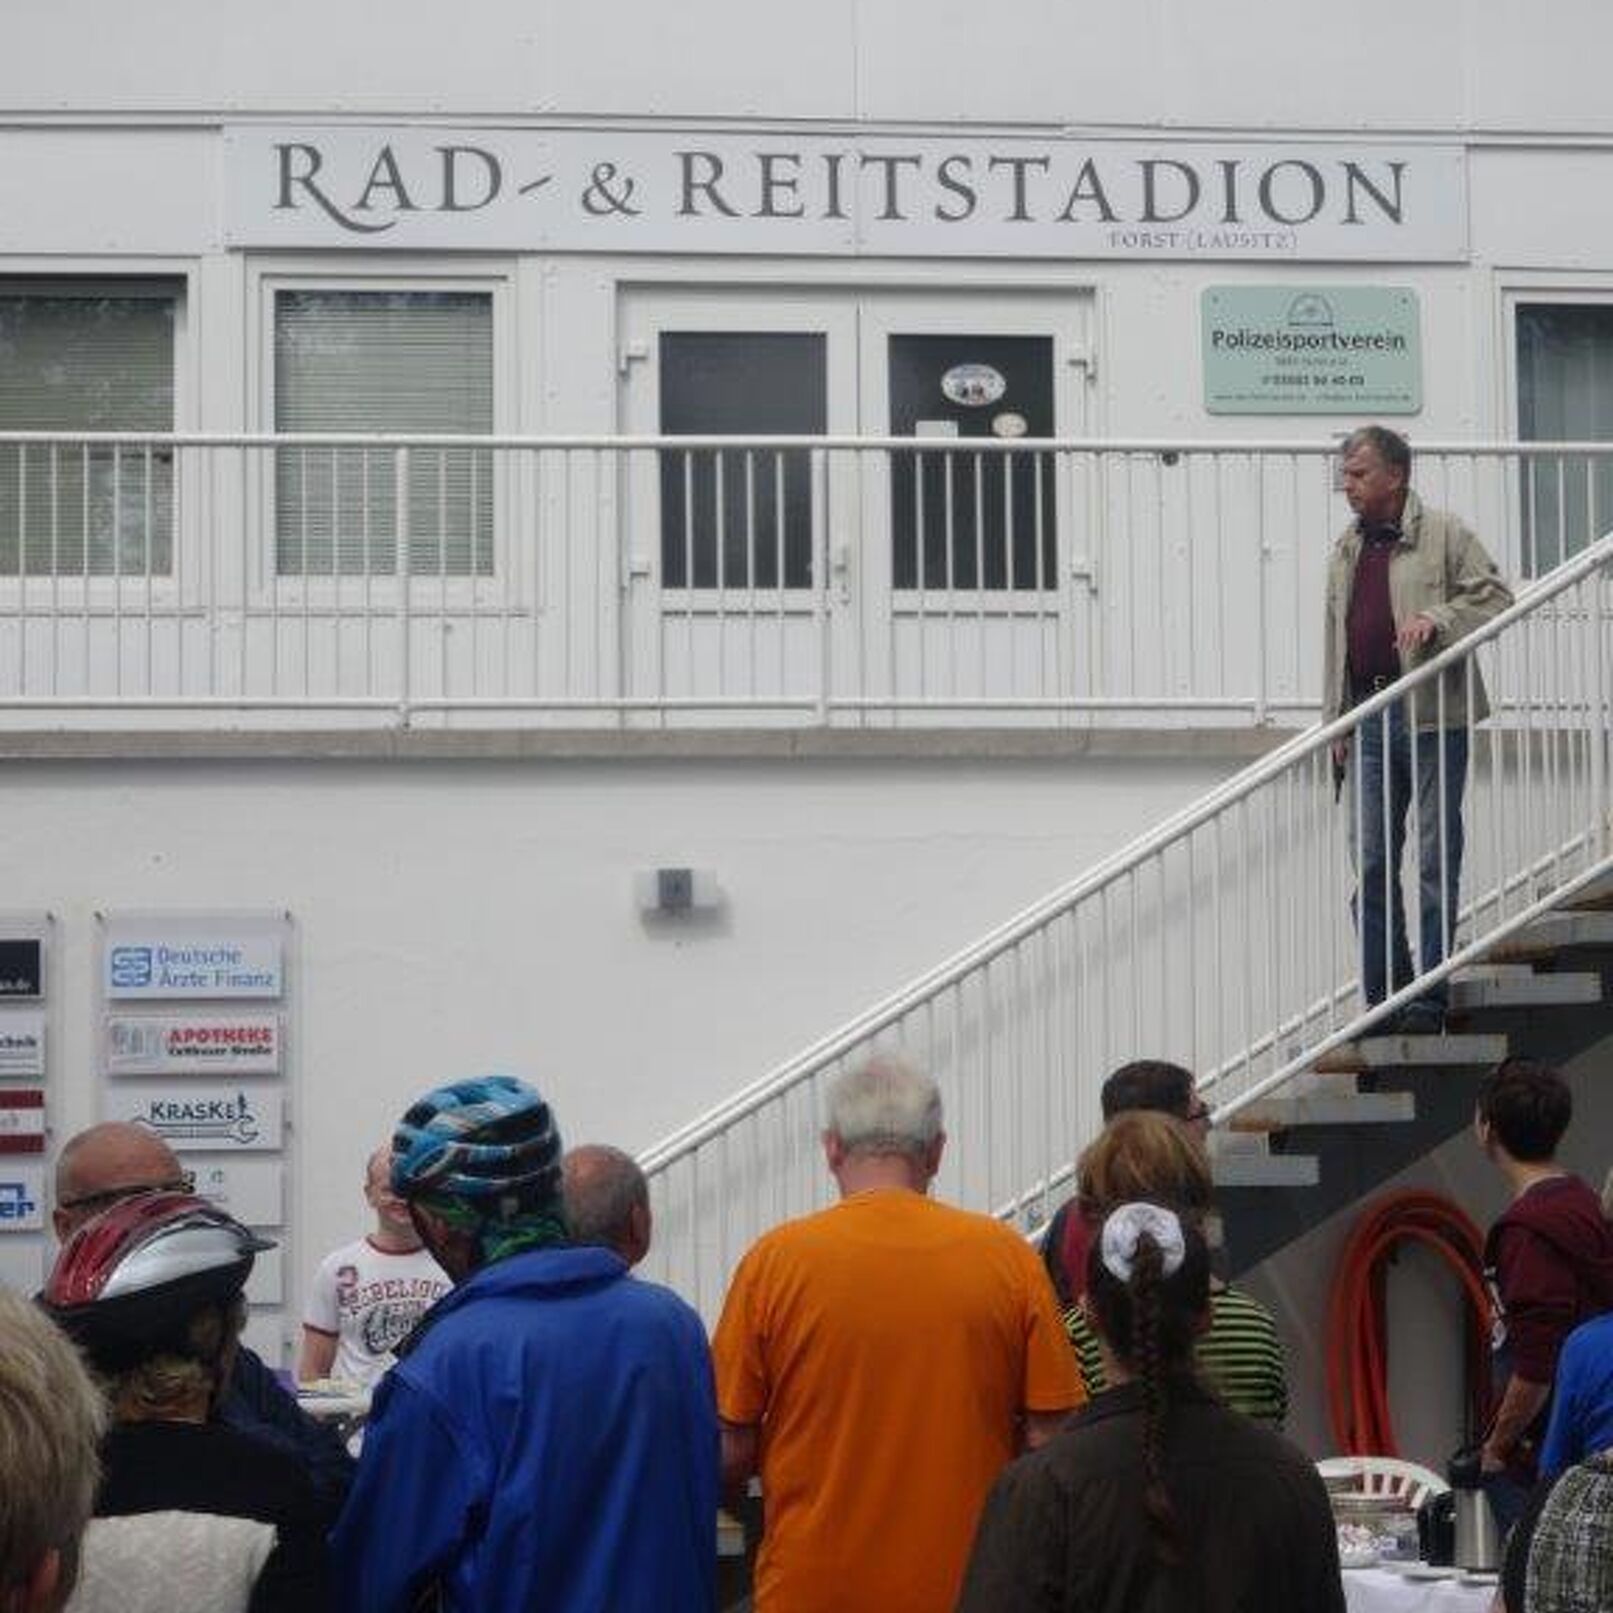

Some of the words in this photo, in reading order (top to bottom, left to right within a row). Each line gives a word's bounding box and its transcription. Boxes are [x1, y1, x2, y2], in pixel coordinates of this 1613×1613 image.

[272, 143, 552, 234] RAD-
[580, 162, 642, 215] &
[673, 150, 1408, 226] REITSTADION
[1109, 230, 1181, 248] FORST
[1211, 328, 1406, 351] Polizeisportverein
[158, 944, 241, 966] Deutsche
[215, 969, 273, 987] Finanz
[169, 1028, 272, 1044] APOTHEKE
